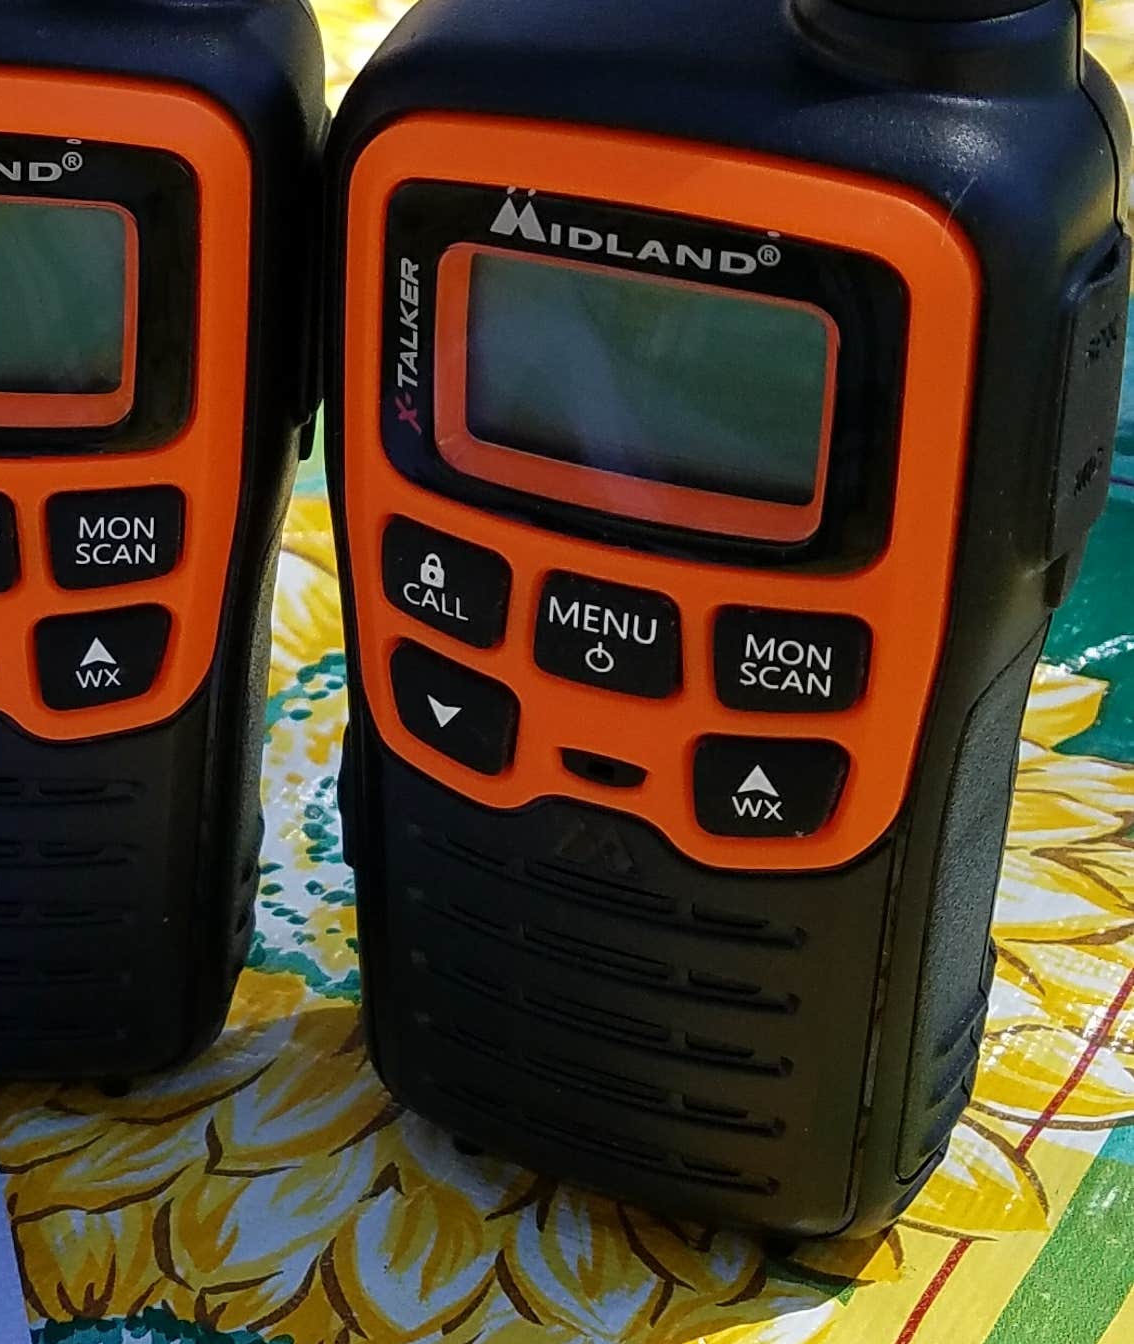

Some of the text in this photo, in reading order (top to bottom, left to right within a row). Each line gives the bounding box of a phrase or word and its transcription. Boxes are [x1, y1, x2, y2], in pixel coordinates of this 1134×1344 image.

[392, 256, 422, 436] X-TALKER
[78, 516, 156, 540] MON
[75, 542, 157, 566] SCAN
[402, 582, 469, 623] CALL
[548, 595, 658, 646] MENU
[744, 633, 832, 670] MON
[75, 667, 122, 688] WX
[738, 662, 832, 698] SCAN
[731, 795, 784, 821] WX
